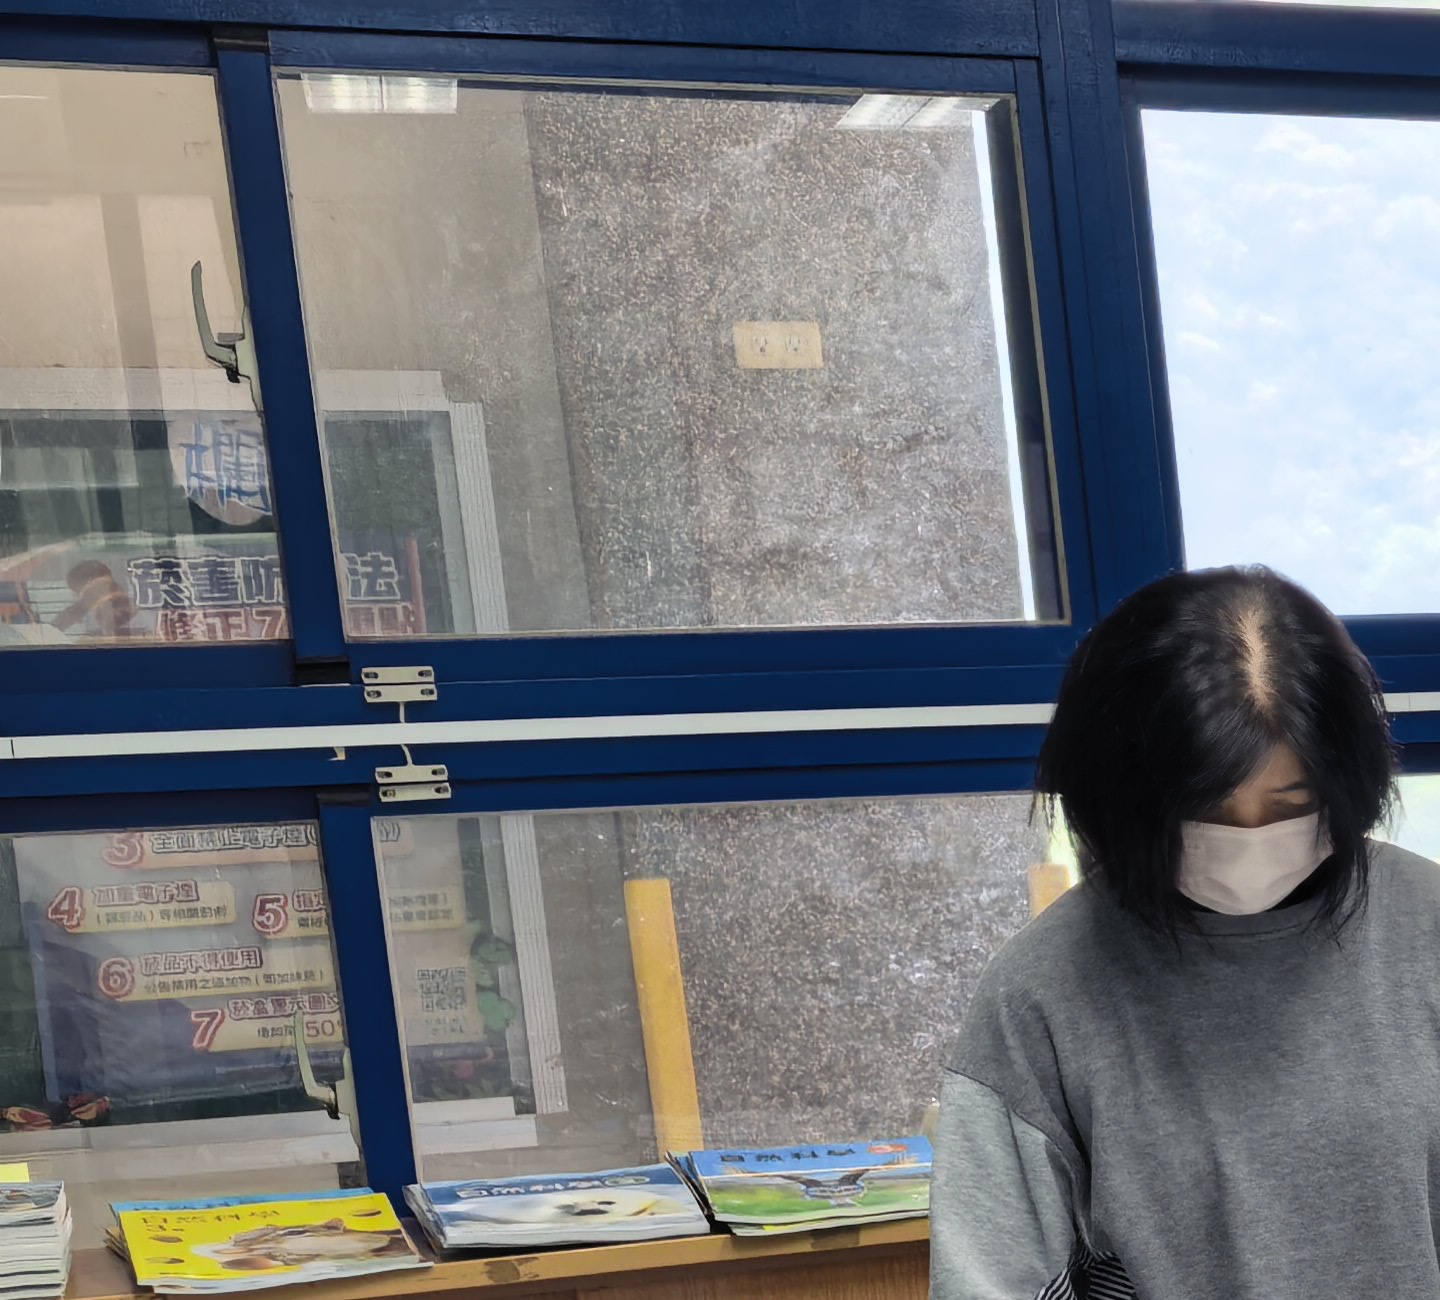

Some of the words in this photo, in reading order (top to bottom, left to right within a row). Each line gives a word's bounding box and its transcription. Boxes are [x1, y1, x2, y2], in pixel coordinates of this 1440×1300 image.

[48, 886, 86, 928] 4
[253, 893, 289, 934] 5
[98, 956, 135, 999] 6
[190, 1009, 225, 1051] 7
